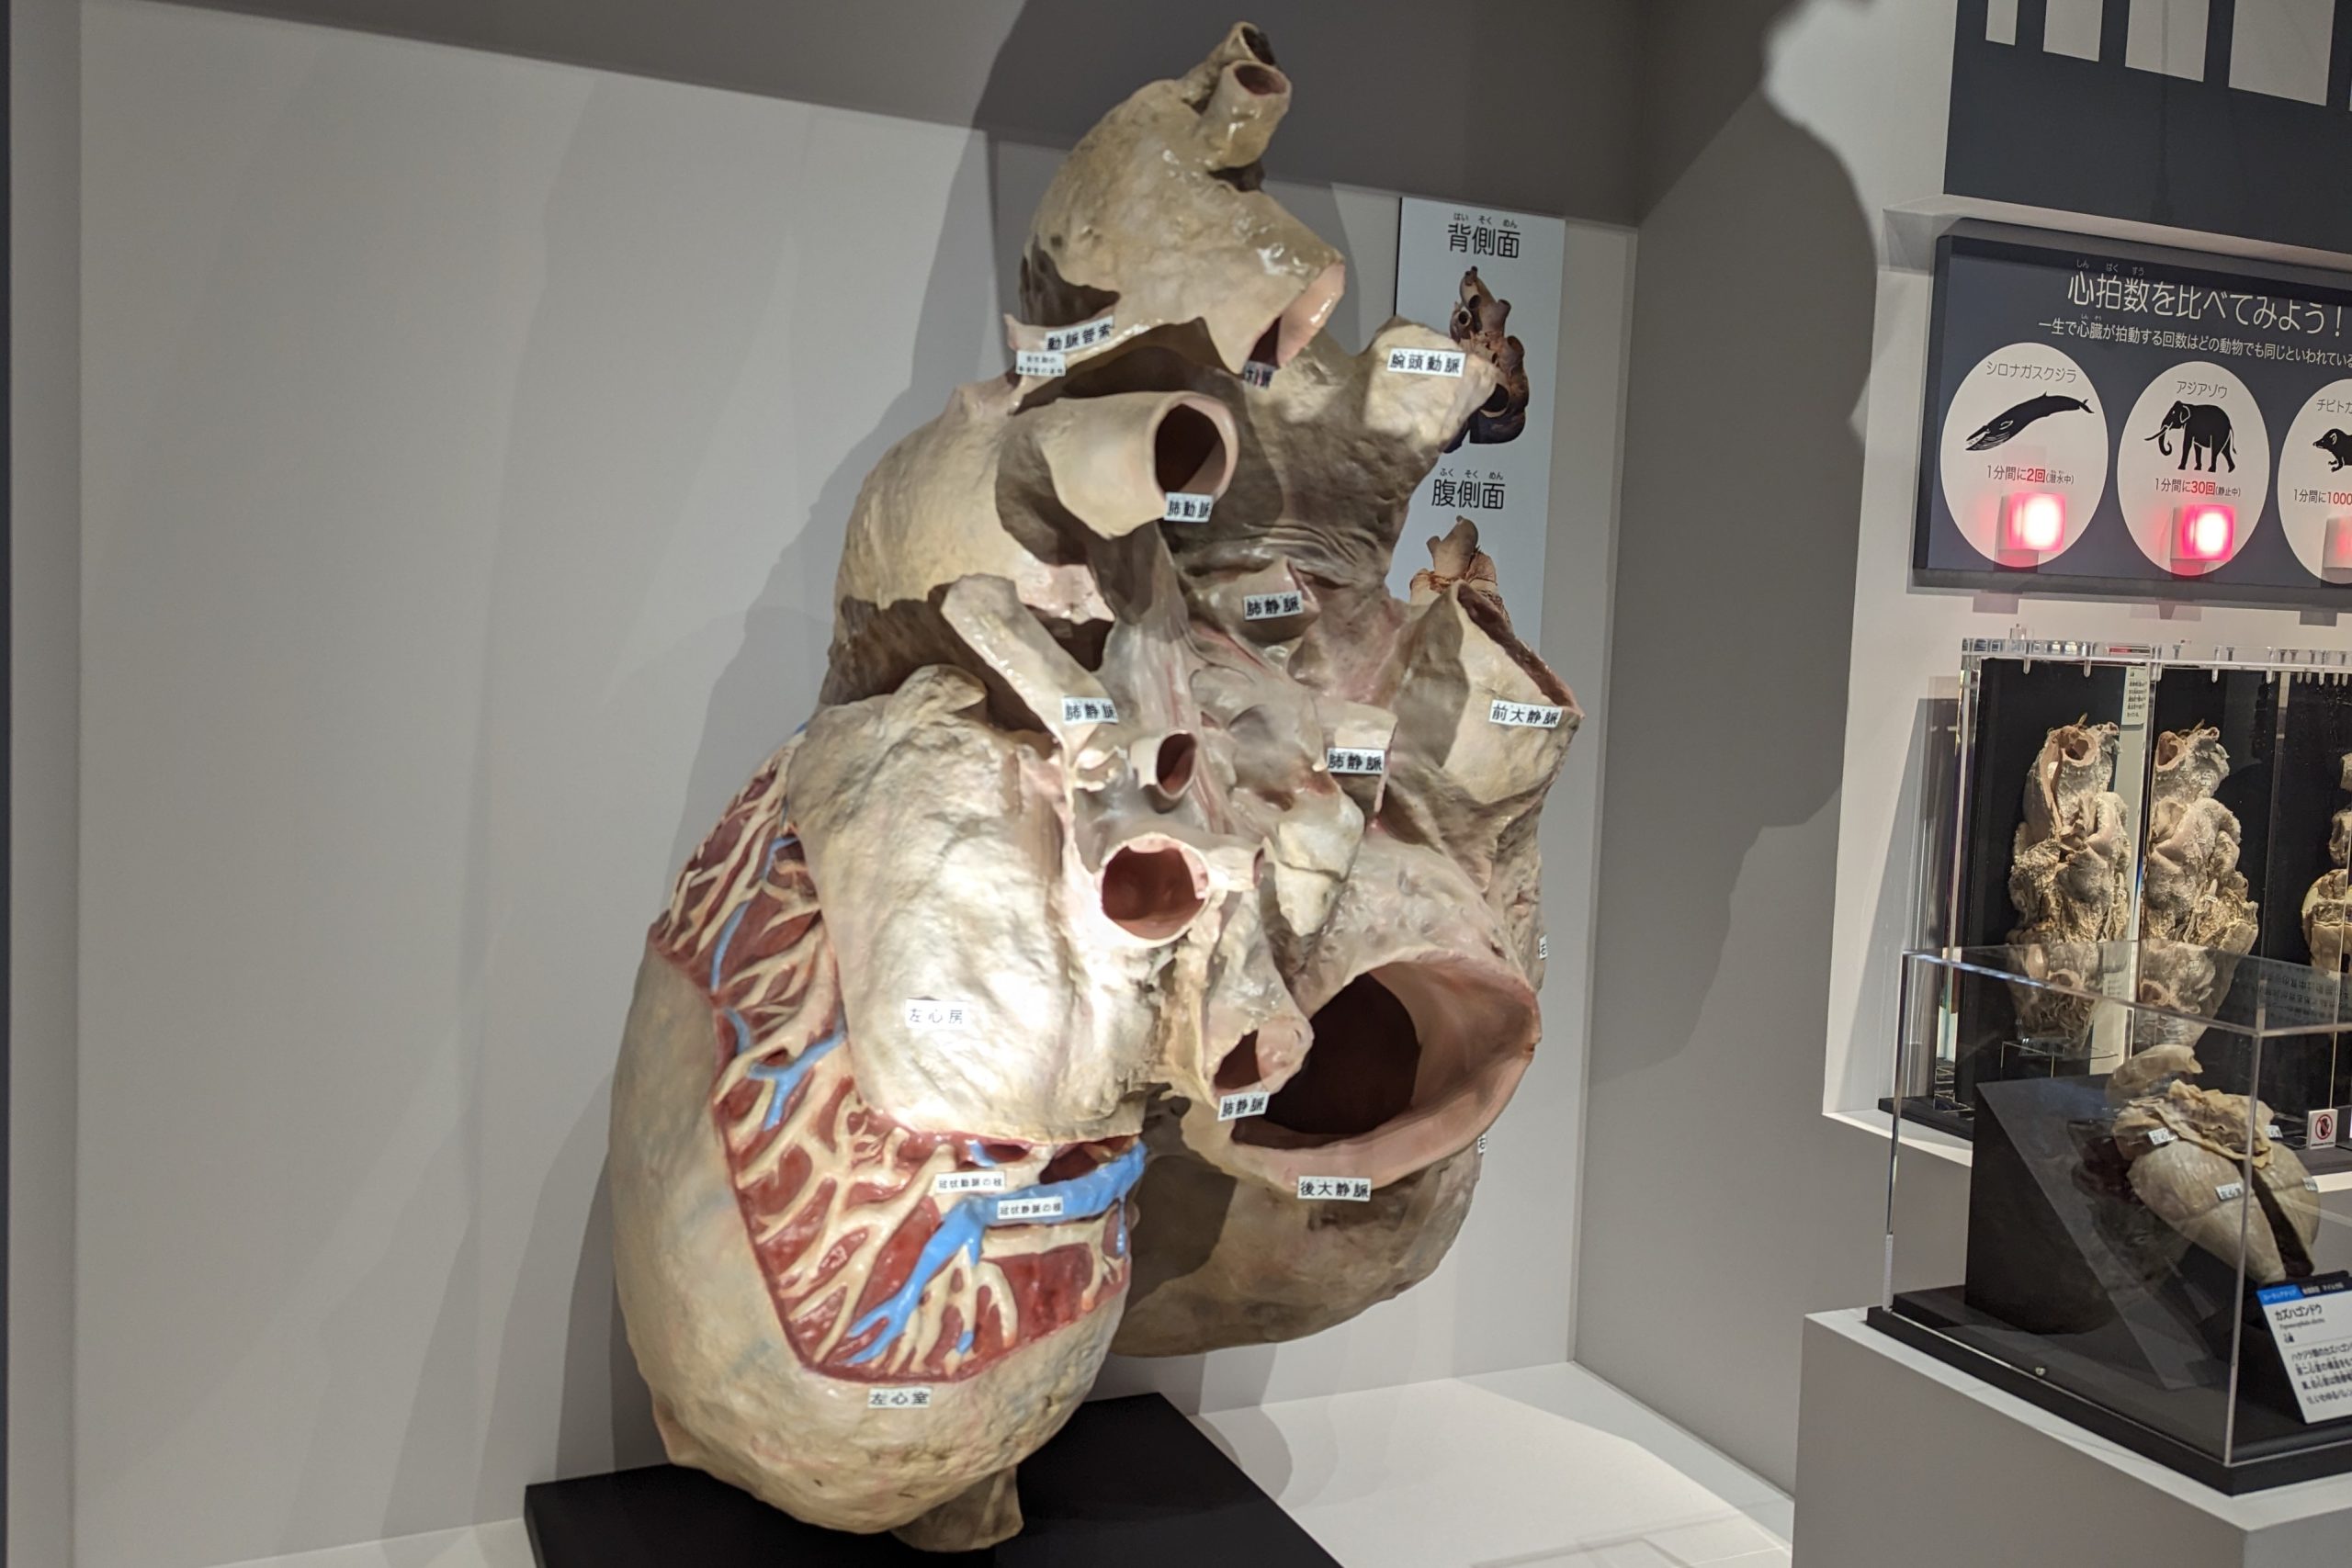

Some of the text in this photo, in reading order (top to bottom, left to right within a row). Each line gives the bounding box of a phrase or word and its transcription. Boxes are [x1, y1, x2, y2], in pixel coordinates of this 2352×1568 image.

[1447, 223, 1521, 259] 背側面
[2067, 270, 2343, 337] 心拍数を比べてみよう！
[1986, 360, 2077, 383] シロナガスクジラ
[1431, 479, 1506, 510] 腹側面
[1492, 704, 1560, 726] 前大静脈
[1300, 1181, 1369, 1199] 後大静脈
